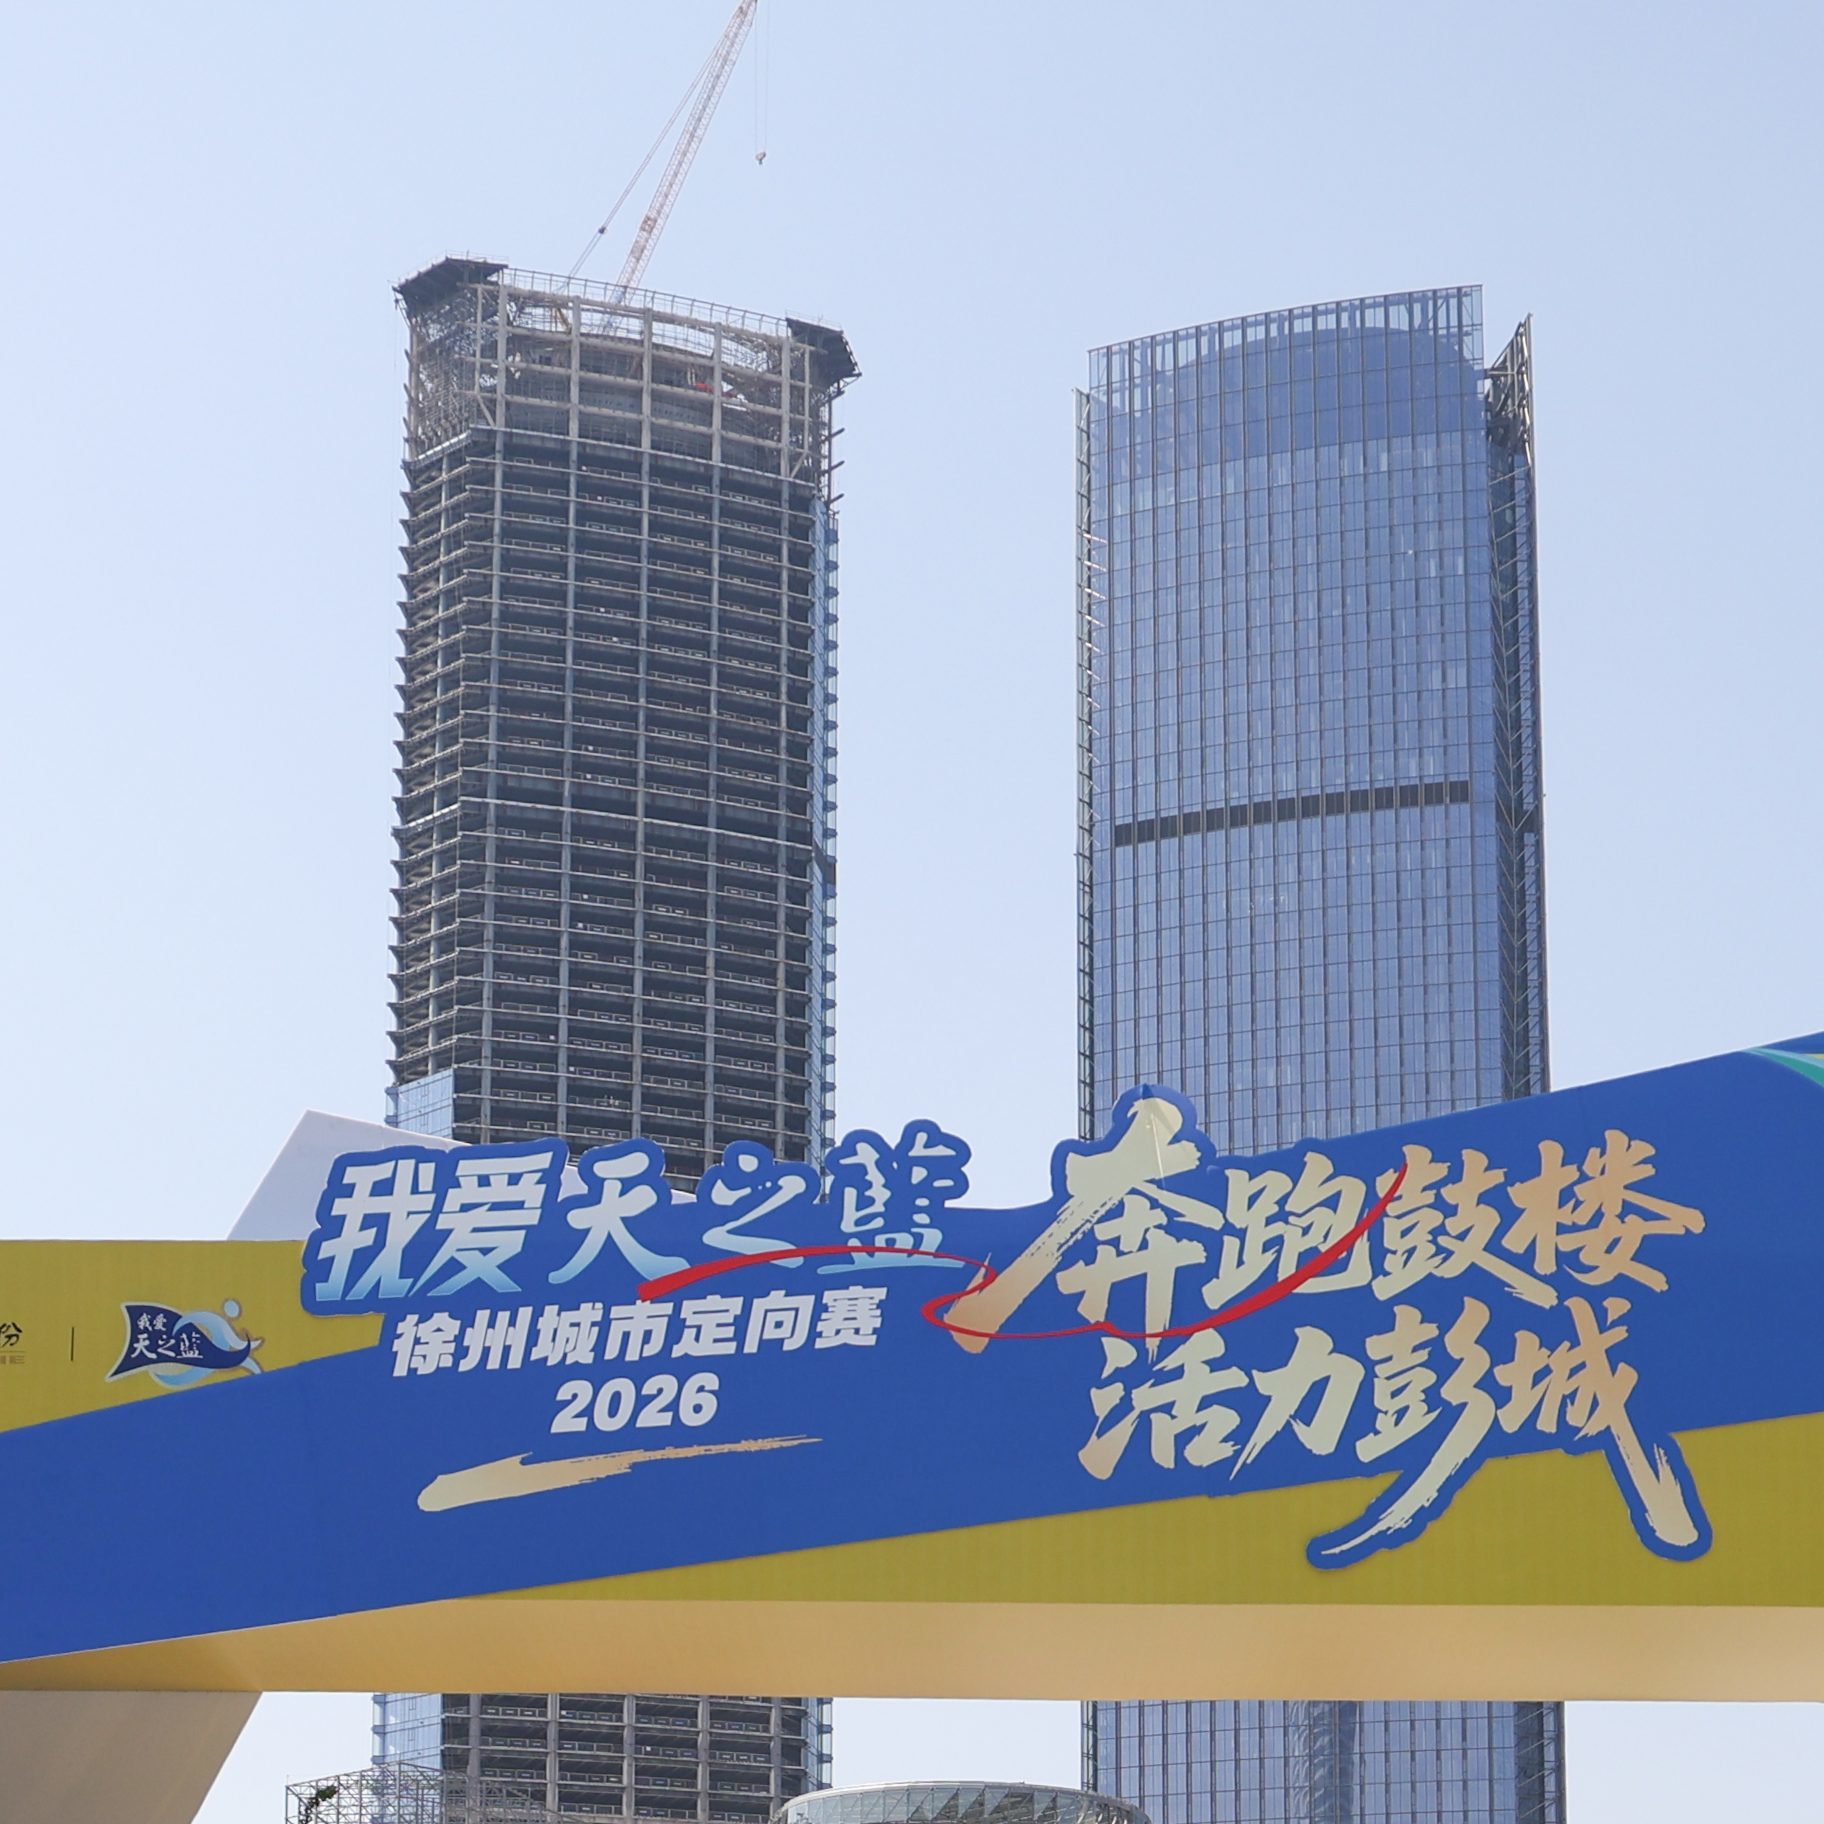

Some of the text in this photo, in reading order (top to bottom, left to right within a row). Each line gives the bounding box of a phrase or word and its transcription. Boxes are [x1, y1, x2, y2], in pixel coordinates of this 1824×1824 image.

[943, 1096, 1706, 1361] 奔跑鼓楼
[137, 1313, 167, 1331] 我爱
[392, 1286, 887, 1377] 徐州城市定向赛
[550, 1373, 720, 1433] 2026
[1078, 1297, 1700, 1555] 活力彭城
